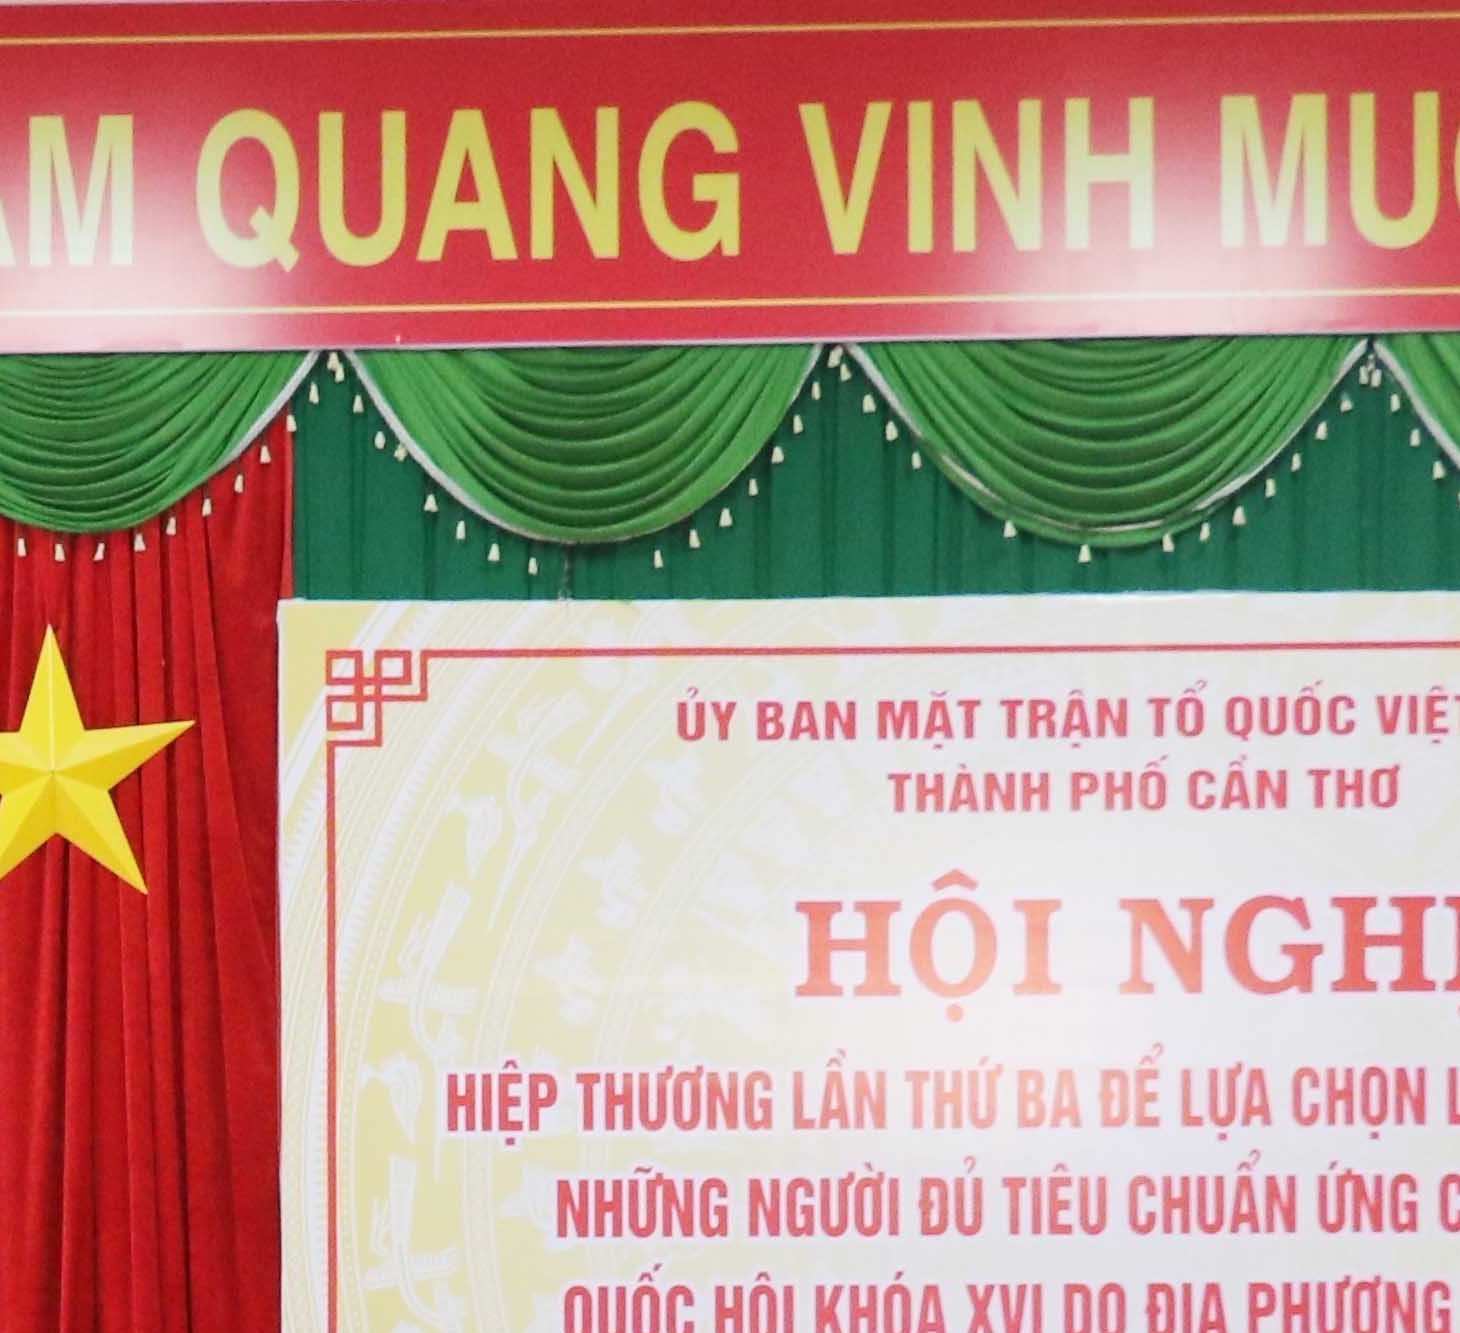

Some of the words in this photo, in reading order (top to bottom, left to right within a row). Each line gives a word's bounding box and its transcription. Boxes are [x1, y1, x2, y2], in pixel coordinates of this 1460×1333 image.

[196, 100, 741, 273] QUANG
[798, 96, 1155, 256] VINH
[676, 687, 738, 742] ỦY
[756, 700, 858, 742] BAN
[876, 690, 982, 750] MẶT
[999, 689, 1129, 748] TRẬN
[1147, 680, 1209, 738] TỔ
[1224, 680, 1358, 742] QUỐC
[887, 763, 1051, 813] THÀNH
[1070, 755, 1169, 812] PHỐ
[1186, 754, 1288, 811] CẦN
[1306, 765, 1401, 810] THƠ
[796, 867, 1062, 1023] HỘI
[446, 1059, 558, 1145] HIỆP
[575, 1063, 773, 1132] THƯƠNG
[792, 1048, 887, 1131] LẦN
[904, 1055, 1004, 1130] THỨ
[1016, 1069, 1082, 1130] BA
[1098, 1043, 1165, 1129] ĐỂ
[1181, 1062, 1273, 1141] LỰA
[1291, 1066, 1427, 1141] CHỌN
[556, 1166, 729, 1239] NHỮNG
[747, 1163, 900, 1237] NGƯỜI
[918, 1155, 982, 1237] ĐỦ
[1001, 1163, 1108, 1236] TIÊU
[1127, 1149, 1297, 1235] CHUẨN
[1317, 1160, 1419, 1235] ỨNG
